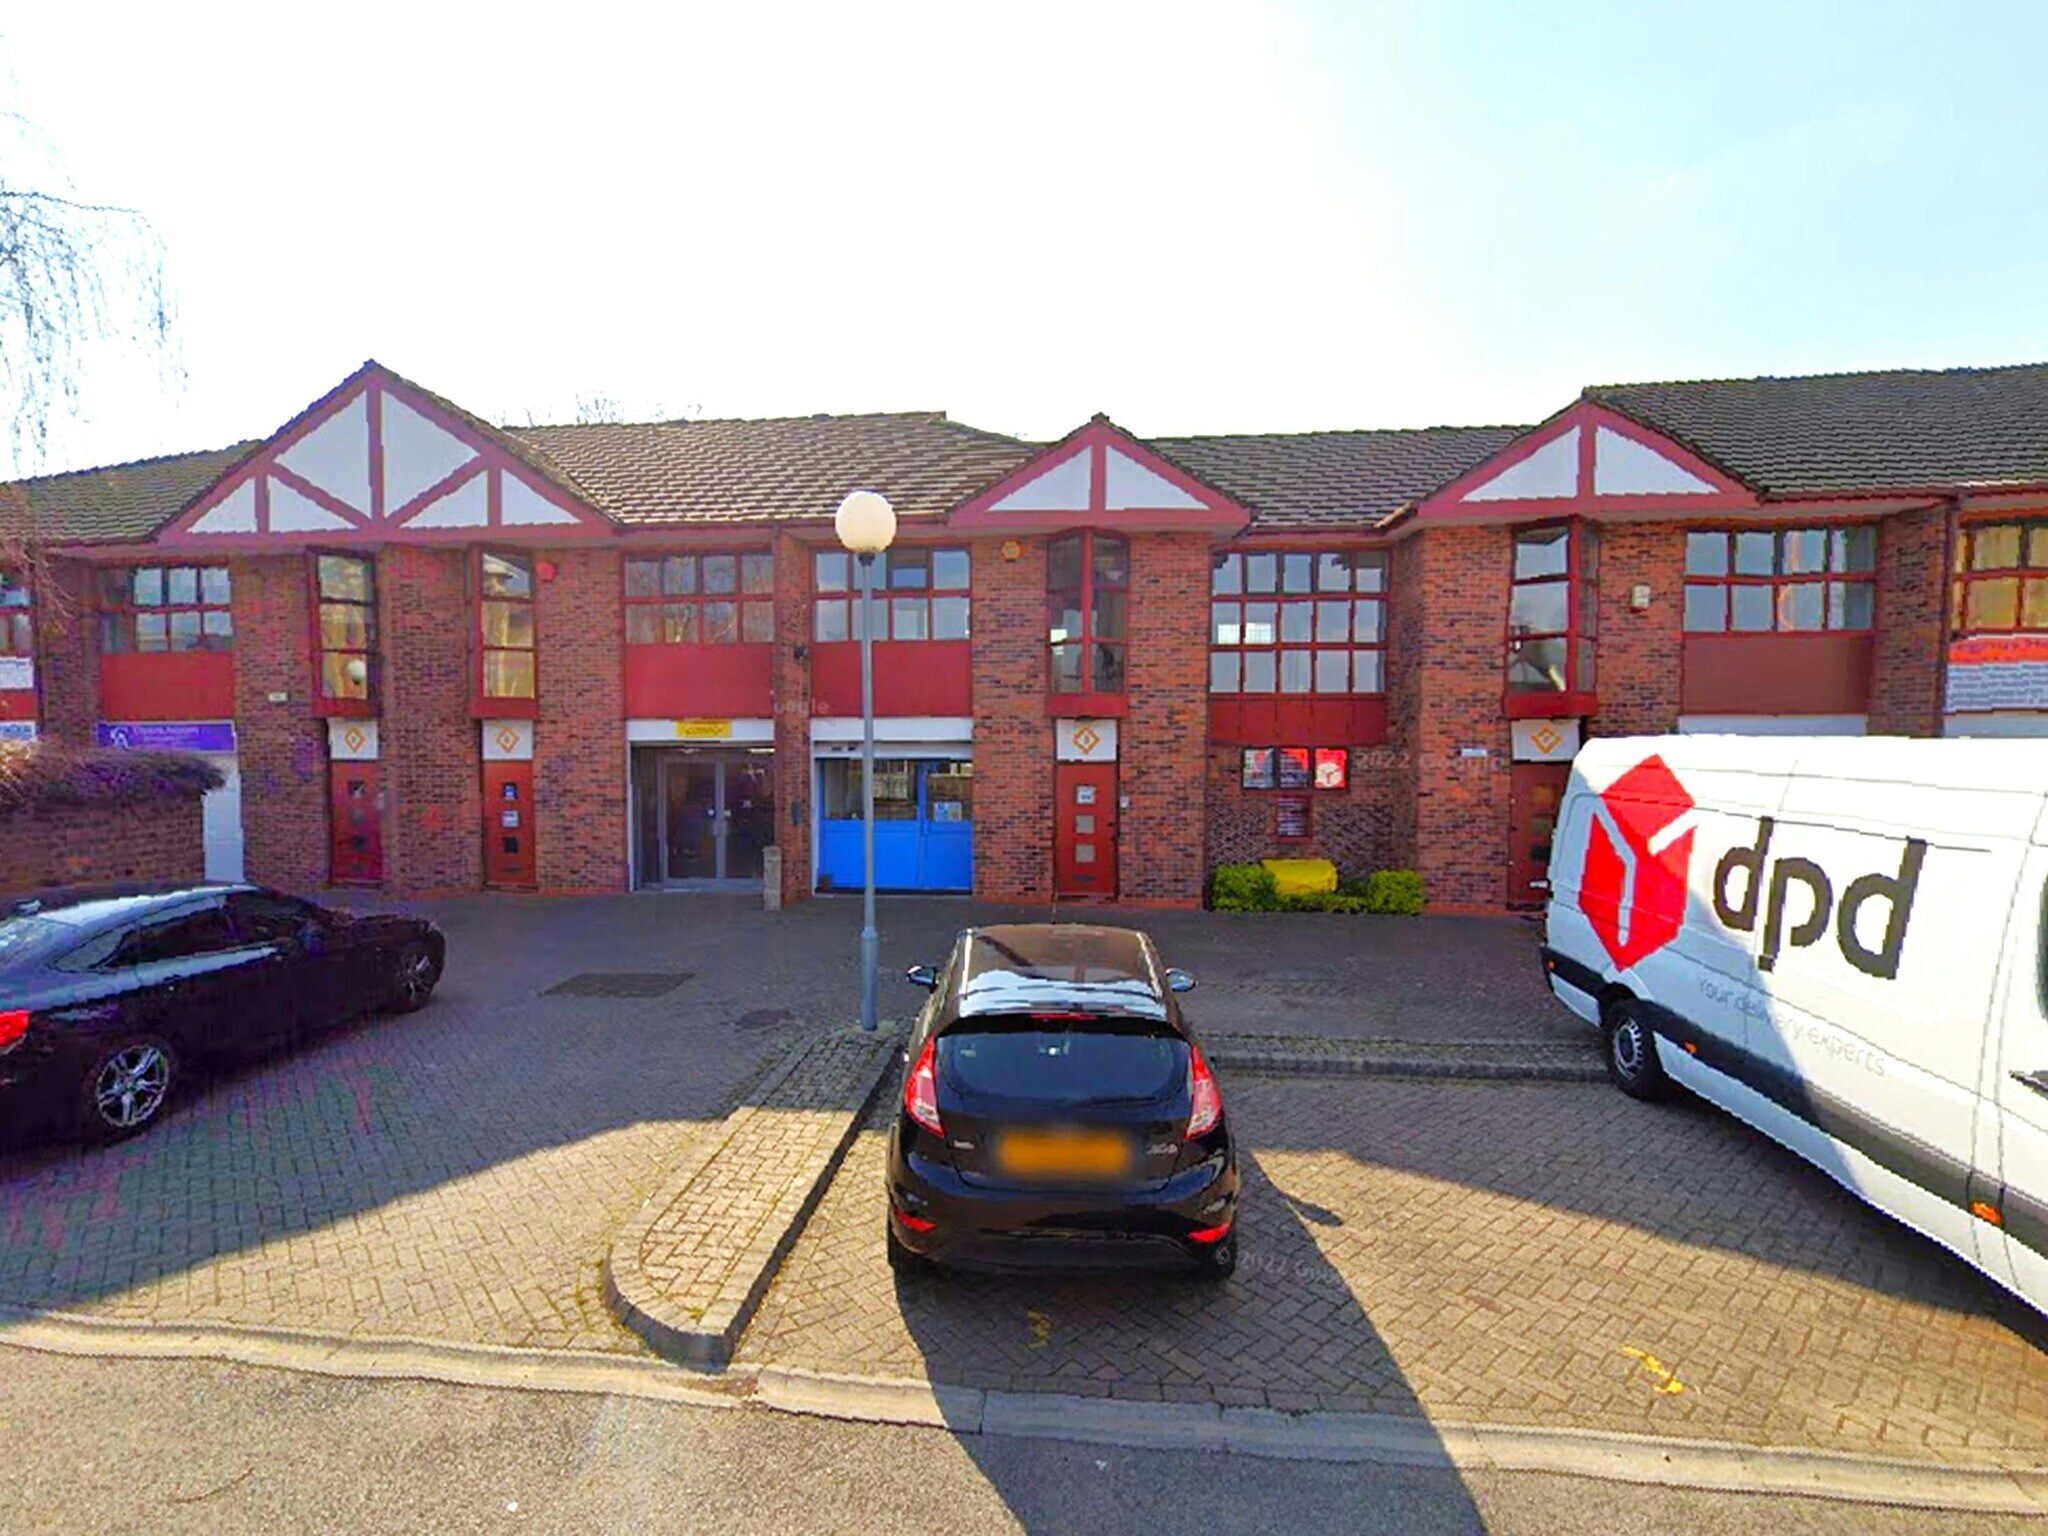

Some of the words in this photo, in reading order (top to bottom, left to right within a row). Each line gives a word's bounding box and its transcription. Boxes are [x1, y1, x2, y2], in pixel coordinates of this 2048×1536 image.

[1713, 816, 1927, 981] dpd
[1734, 988, 1804, 1040] deliery
[1807, 1025, 1887, 1078] experts
